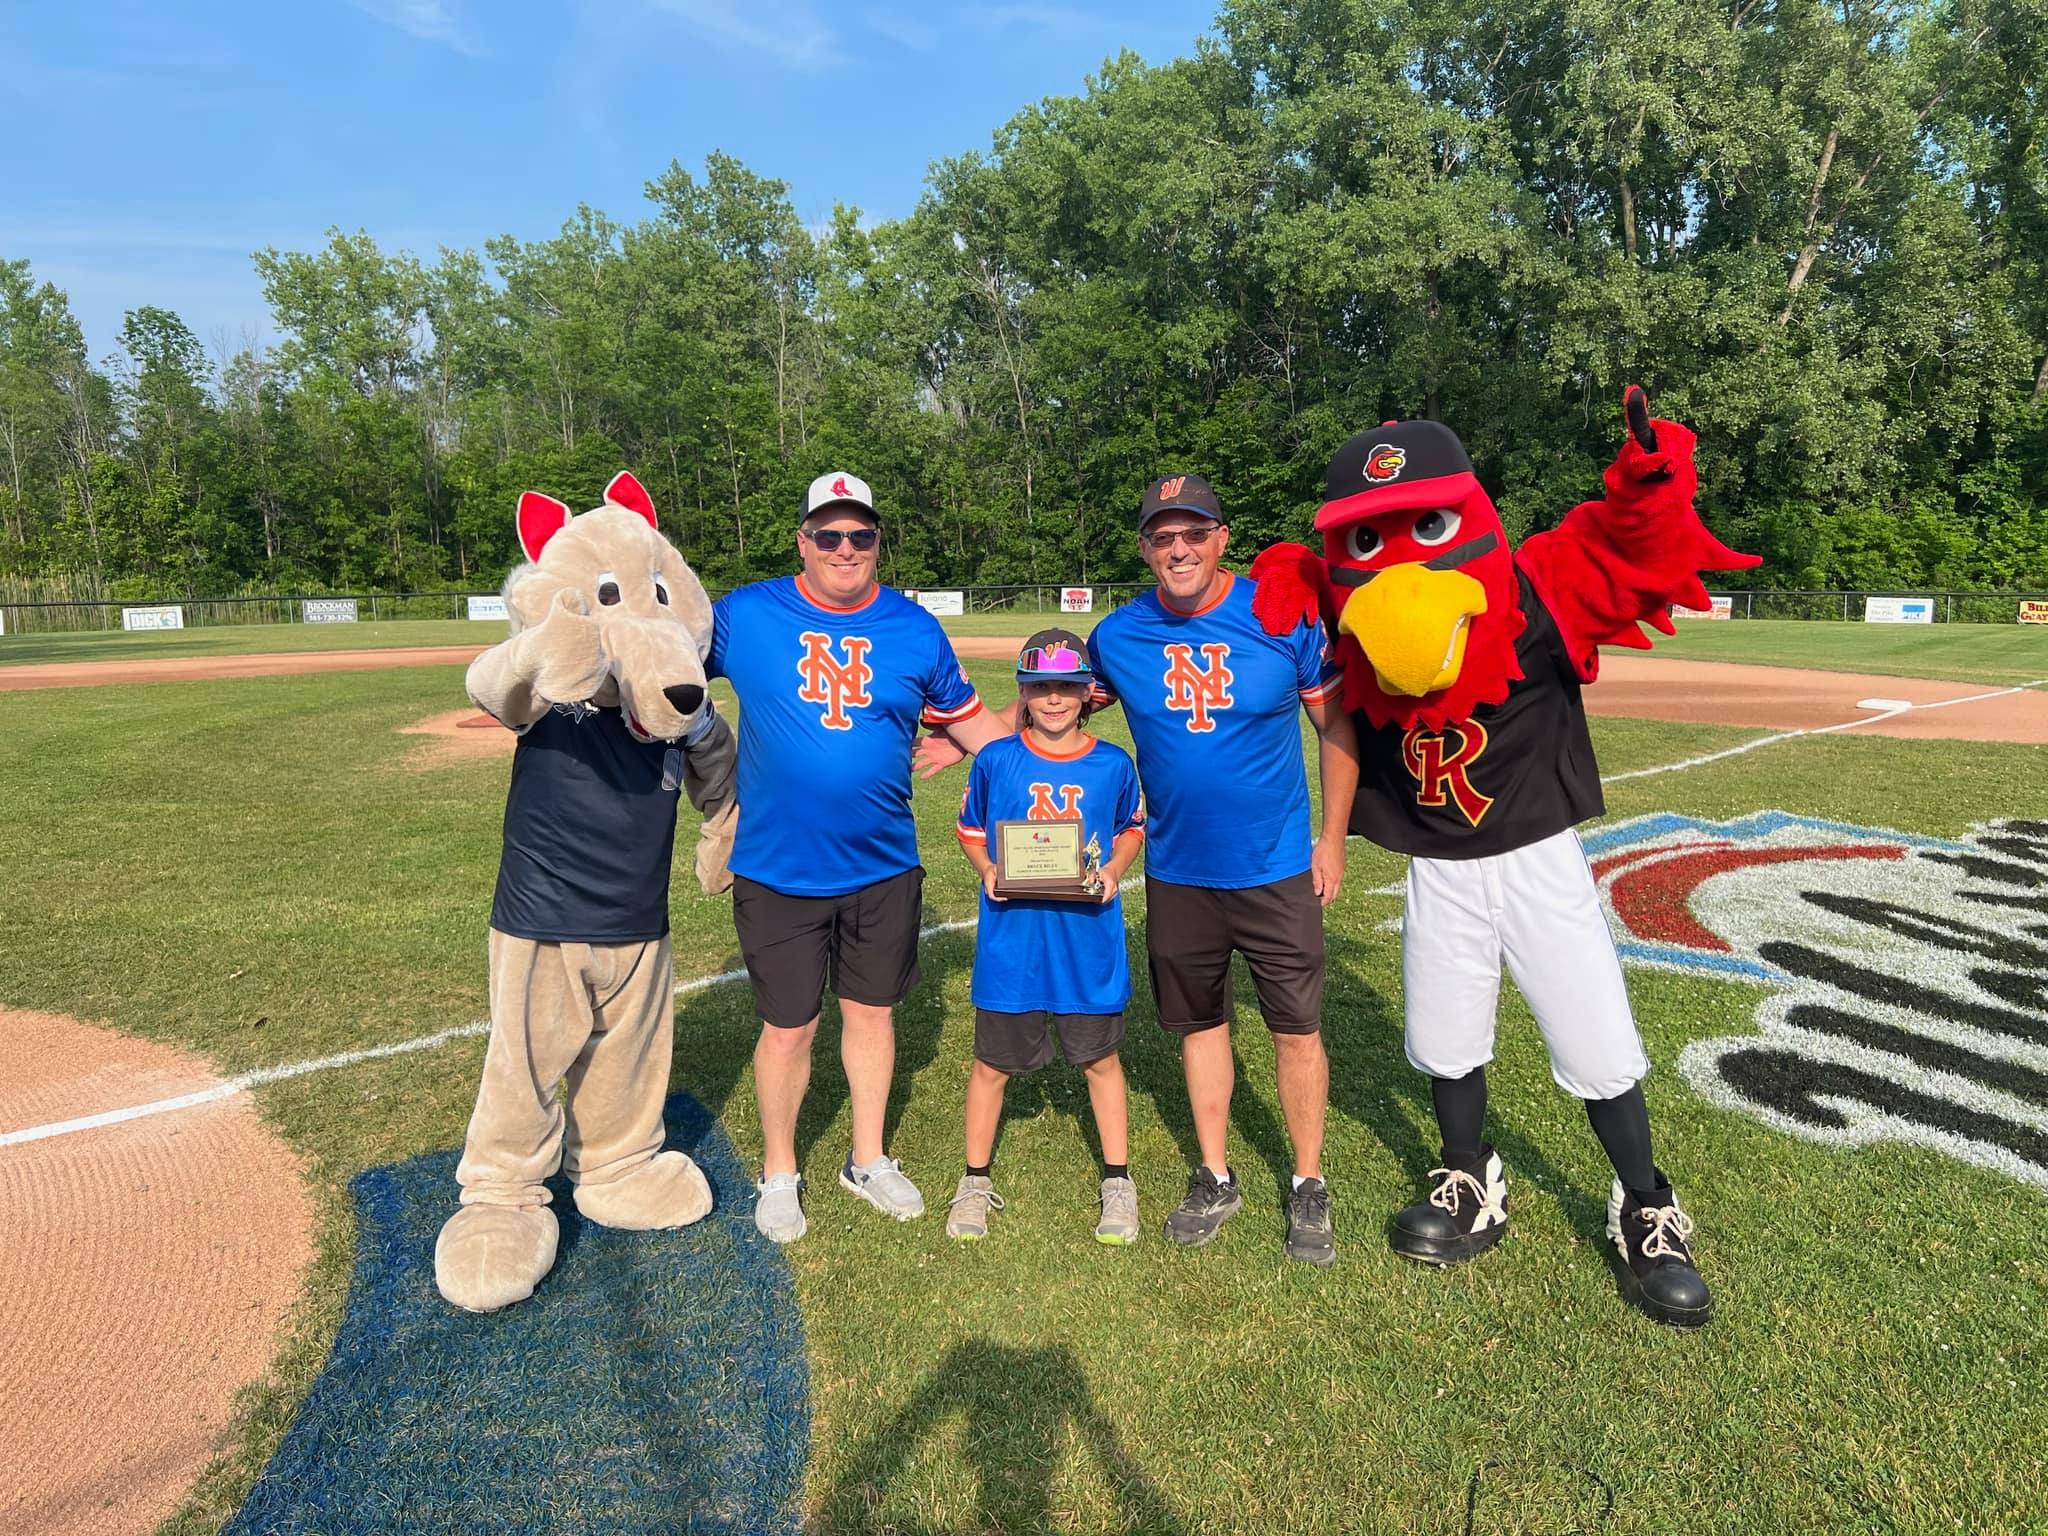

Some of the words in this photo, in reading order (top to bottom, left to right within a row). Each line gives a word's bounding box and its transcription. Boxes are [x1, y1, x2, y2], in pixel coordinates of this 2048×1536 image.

[307, 602, 354, 613] BROCKMAN
[797, 631, 873, 731] NY
[1163, 642, 1234, 733] NY
